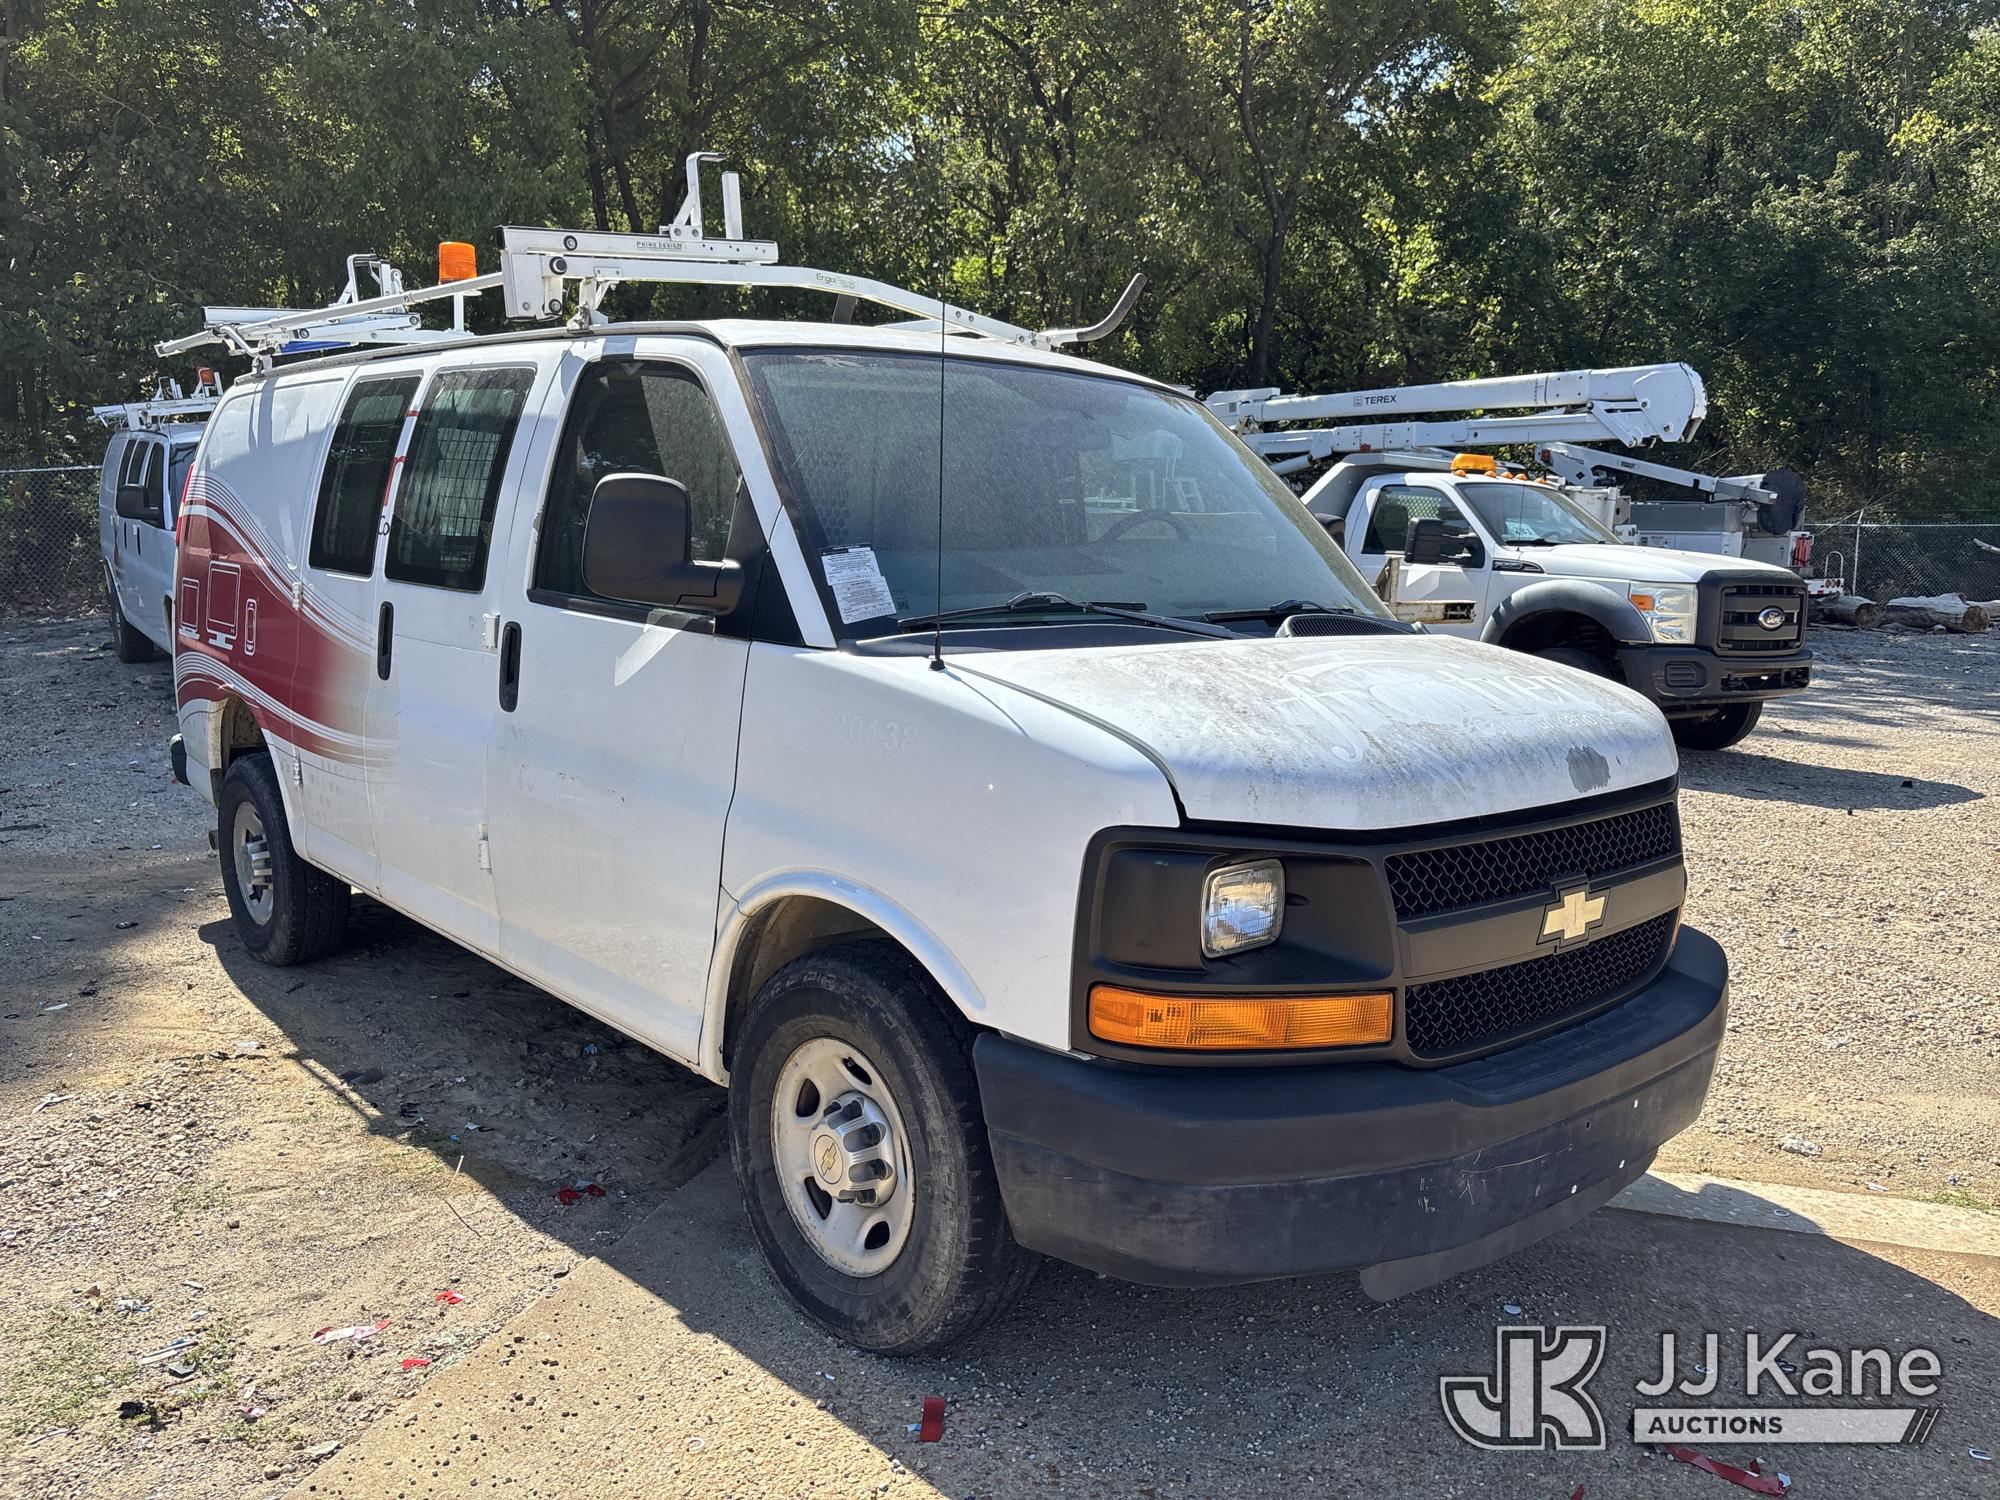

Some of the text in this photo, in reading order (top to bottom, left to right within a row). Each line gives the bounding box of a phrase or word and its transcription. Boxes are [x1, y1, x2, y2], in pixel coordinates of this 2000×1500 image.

[636, 240, 682, 250] PRIME DESIGN
[1364, 394, 1397, 405] TEREX
